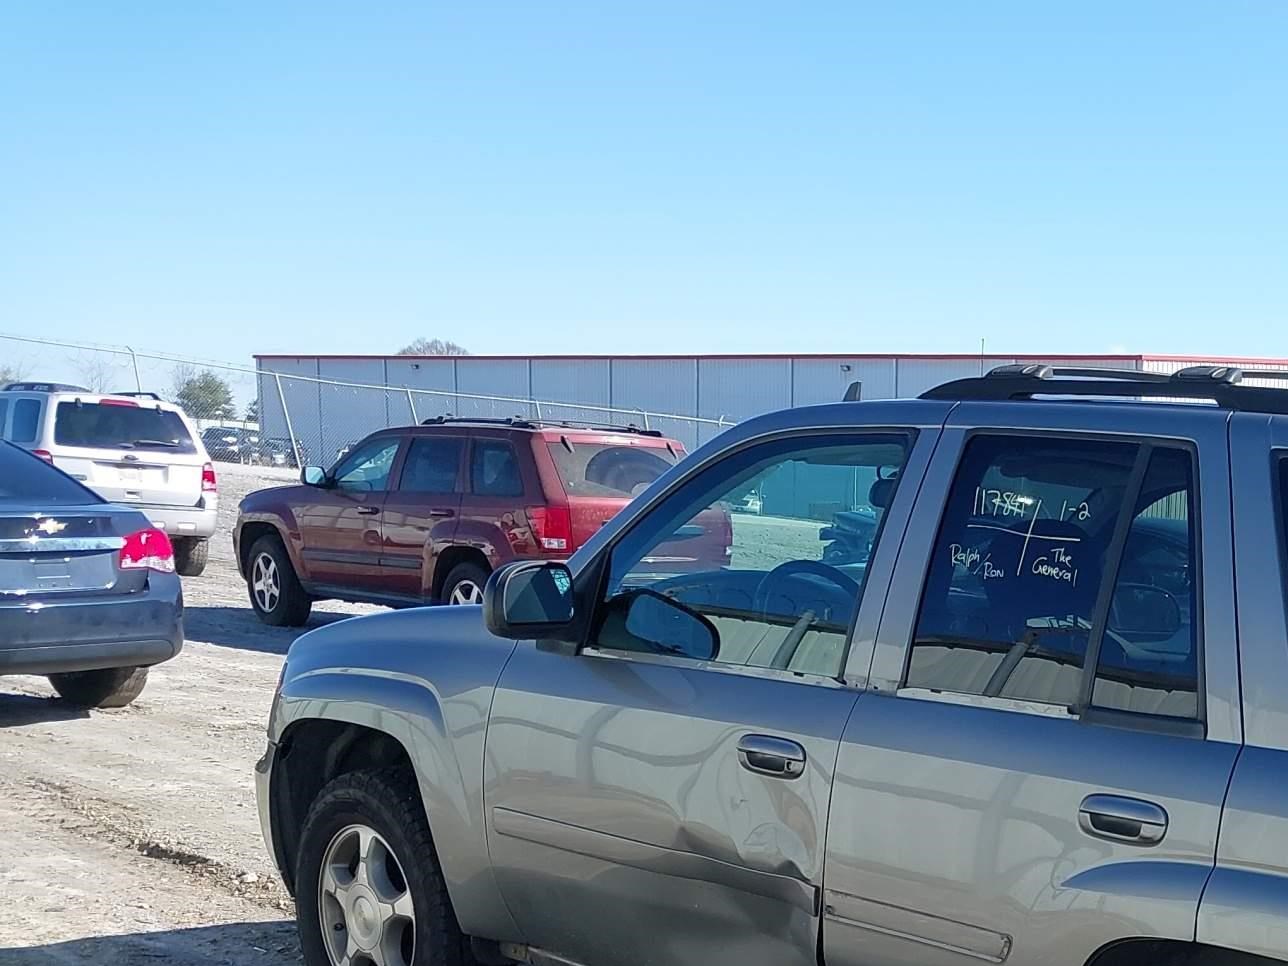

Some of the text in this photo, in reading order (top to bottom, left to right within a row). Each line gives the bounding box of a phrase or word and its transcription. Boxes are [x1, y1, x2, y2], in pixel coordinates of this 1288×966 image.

[1060, 499, 1091, 521] 1-2
[1050, 547, 1072, 568] The
[1031, 556, 1078, 588] General
